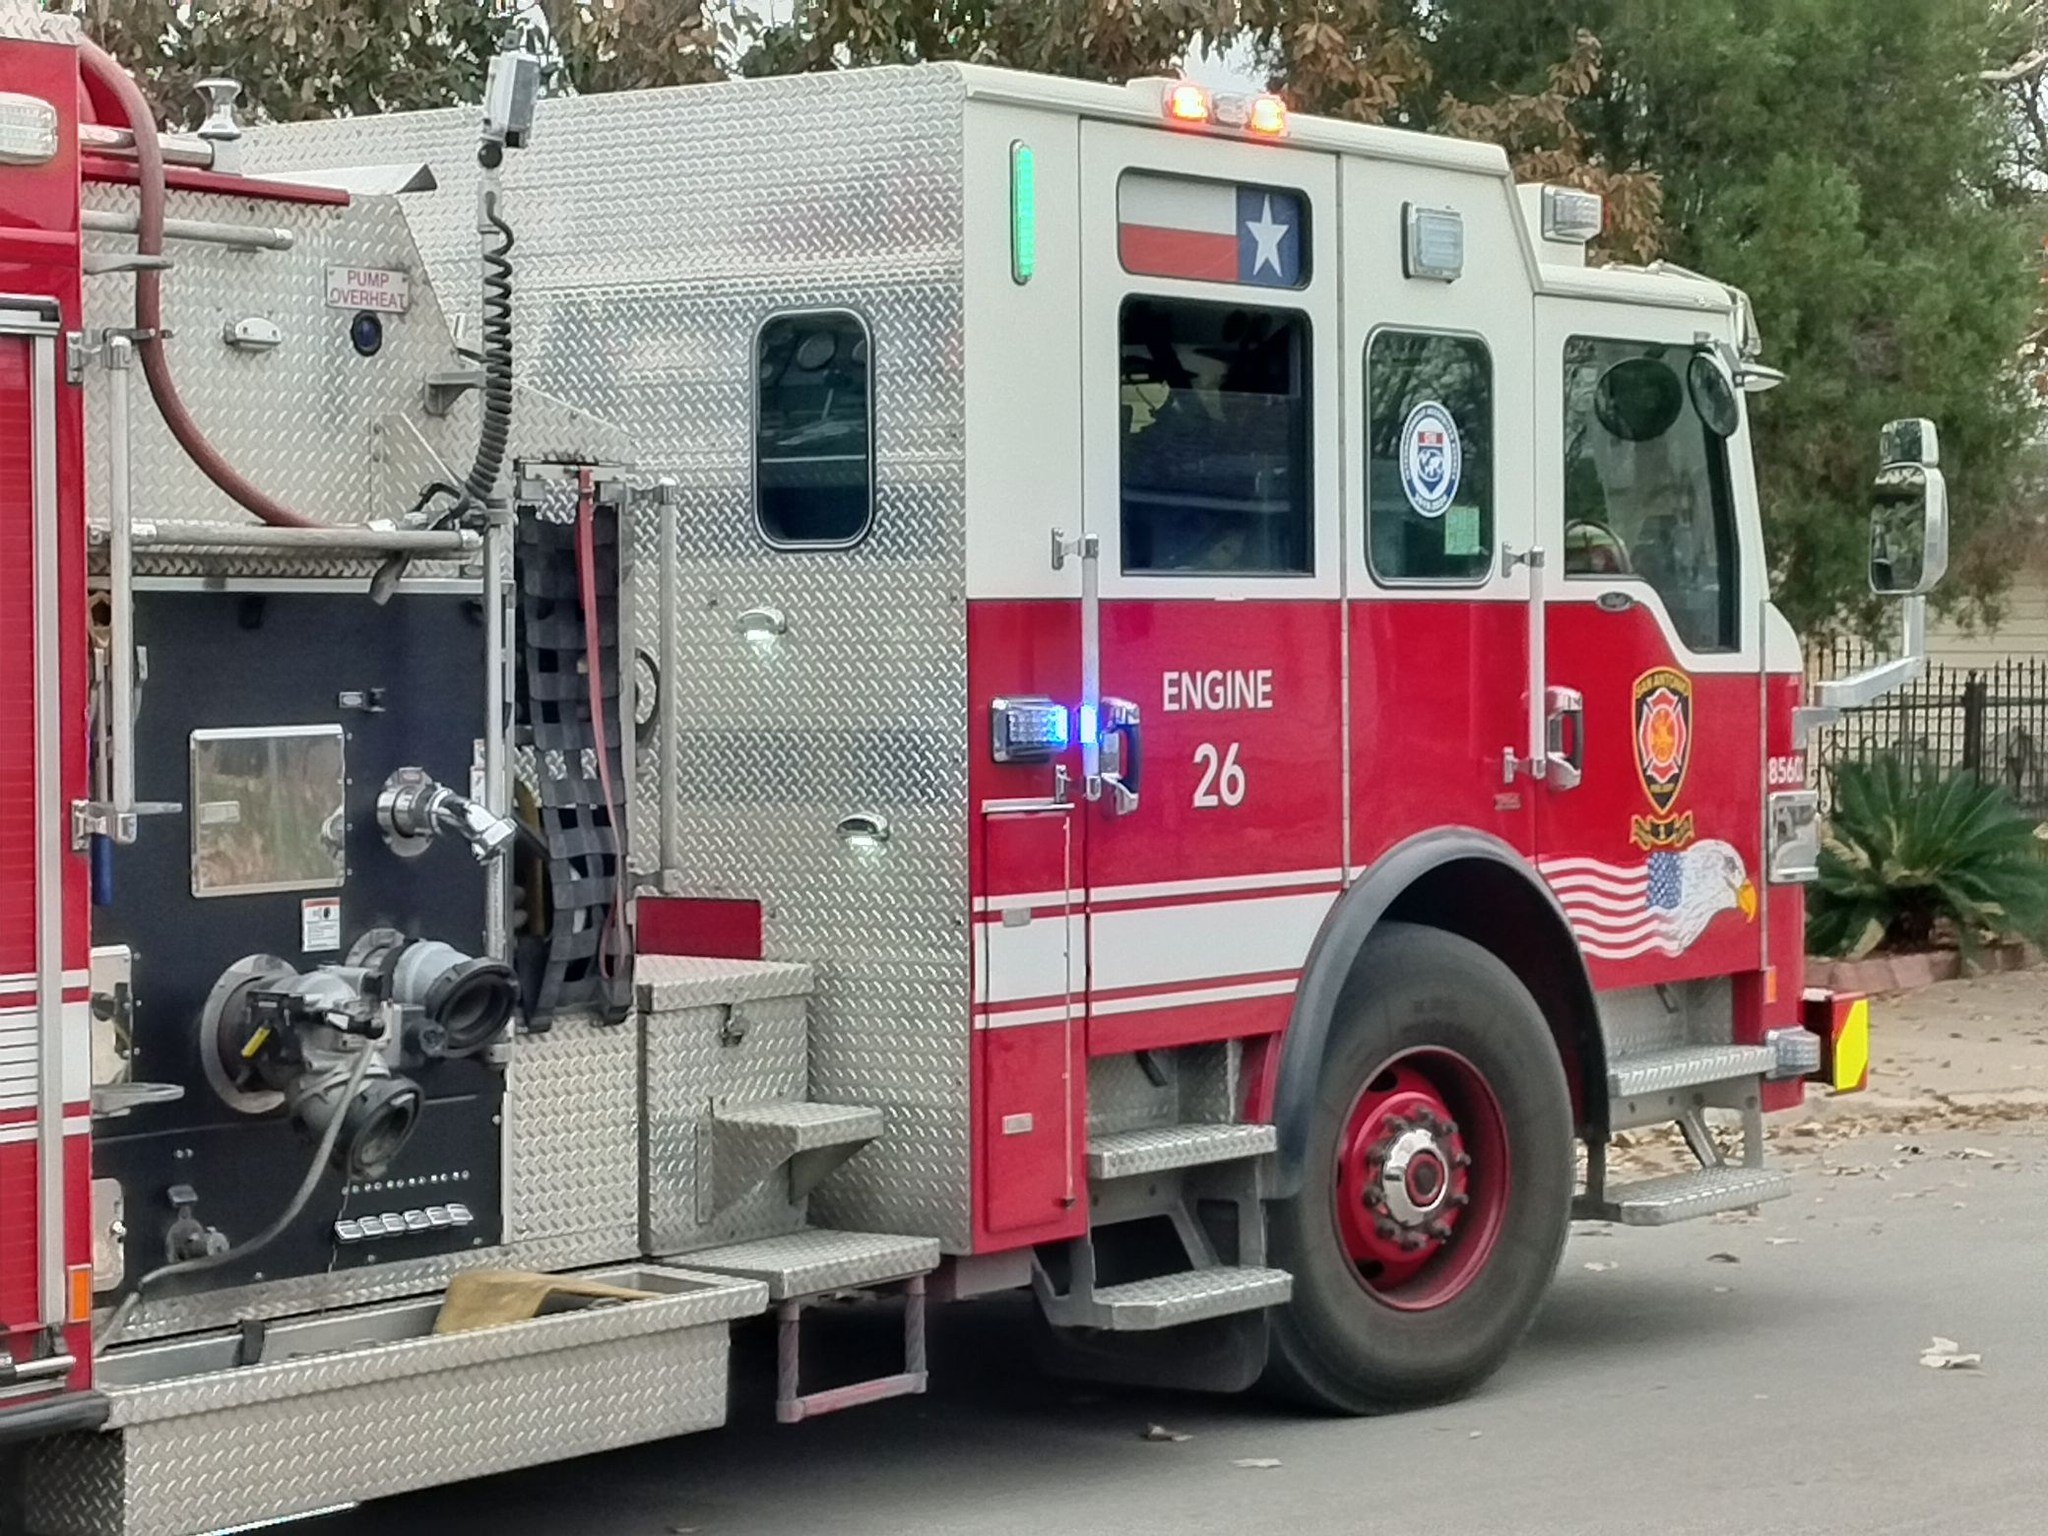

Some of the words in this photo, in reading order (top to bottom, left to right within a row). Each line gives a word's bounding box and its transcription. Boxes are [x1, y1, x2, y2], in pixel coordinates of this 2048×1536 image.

[347, 269, 390, 288] PUMP
[329, 287, 406, 309] OVERHEAT
[1162, 669, 1274, 712] ENGINE
[1192, 742, 1246, 808] 26
